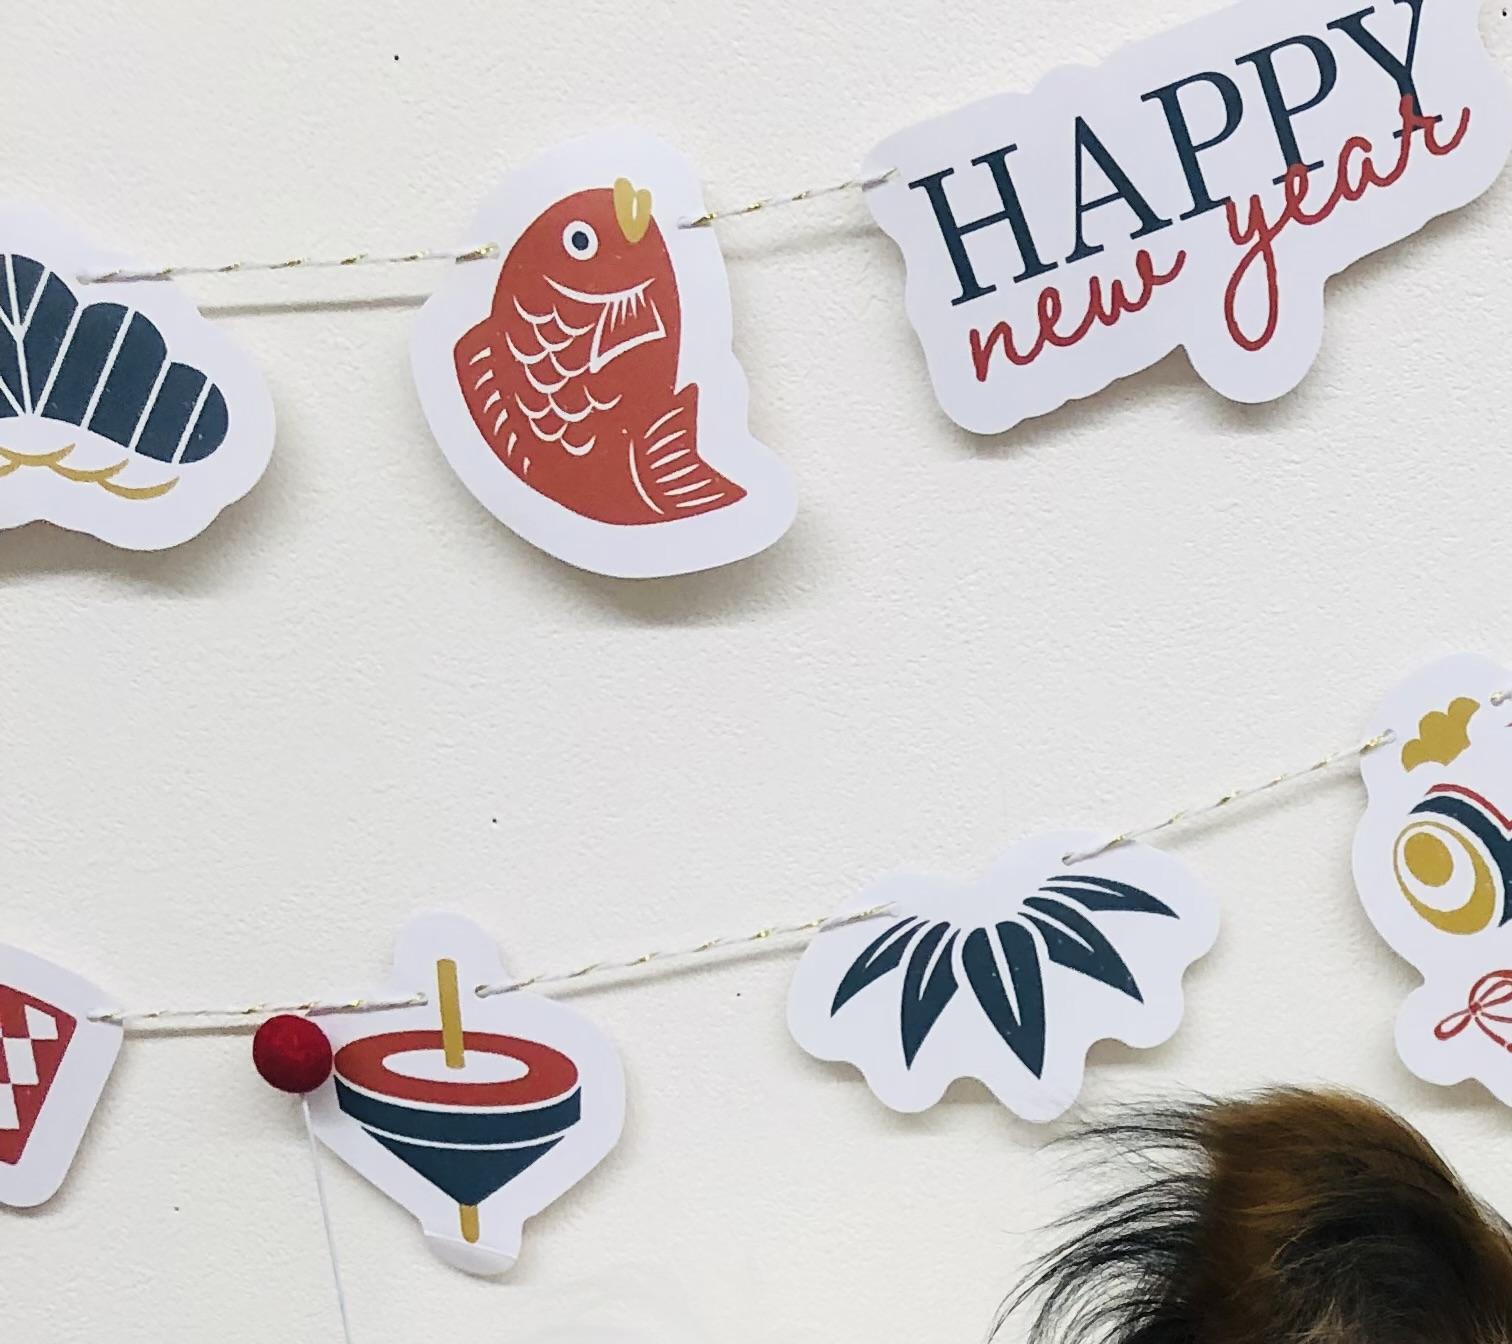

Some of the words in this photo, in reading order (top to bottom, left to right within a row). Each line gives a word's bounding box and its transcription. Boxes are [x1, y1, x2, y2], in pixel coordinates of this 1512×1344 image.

[907, 0, 1443, 308] HAPPY
[969, 249, 1186, 382] new
[1224, 94, 1470, 352] year
